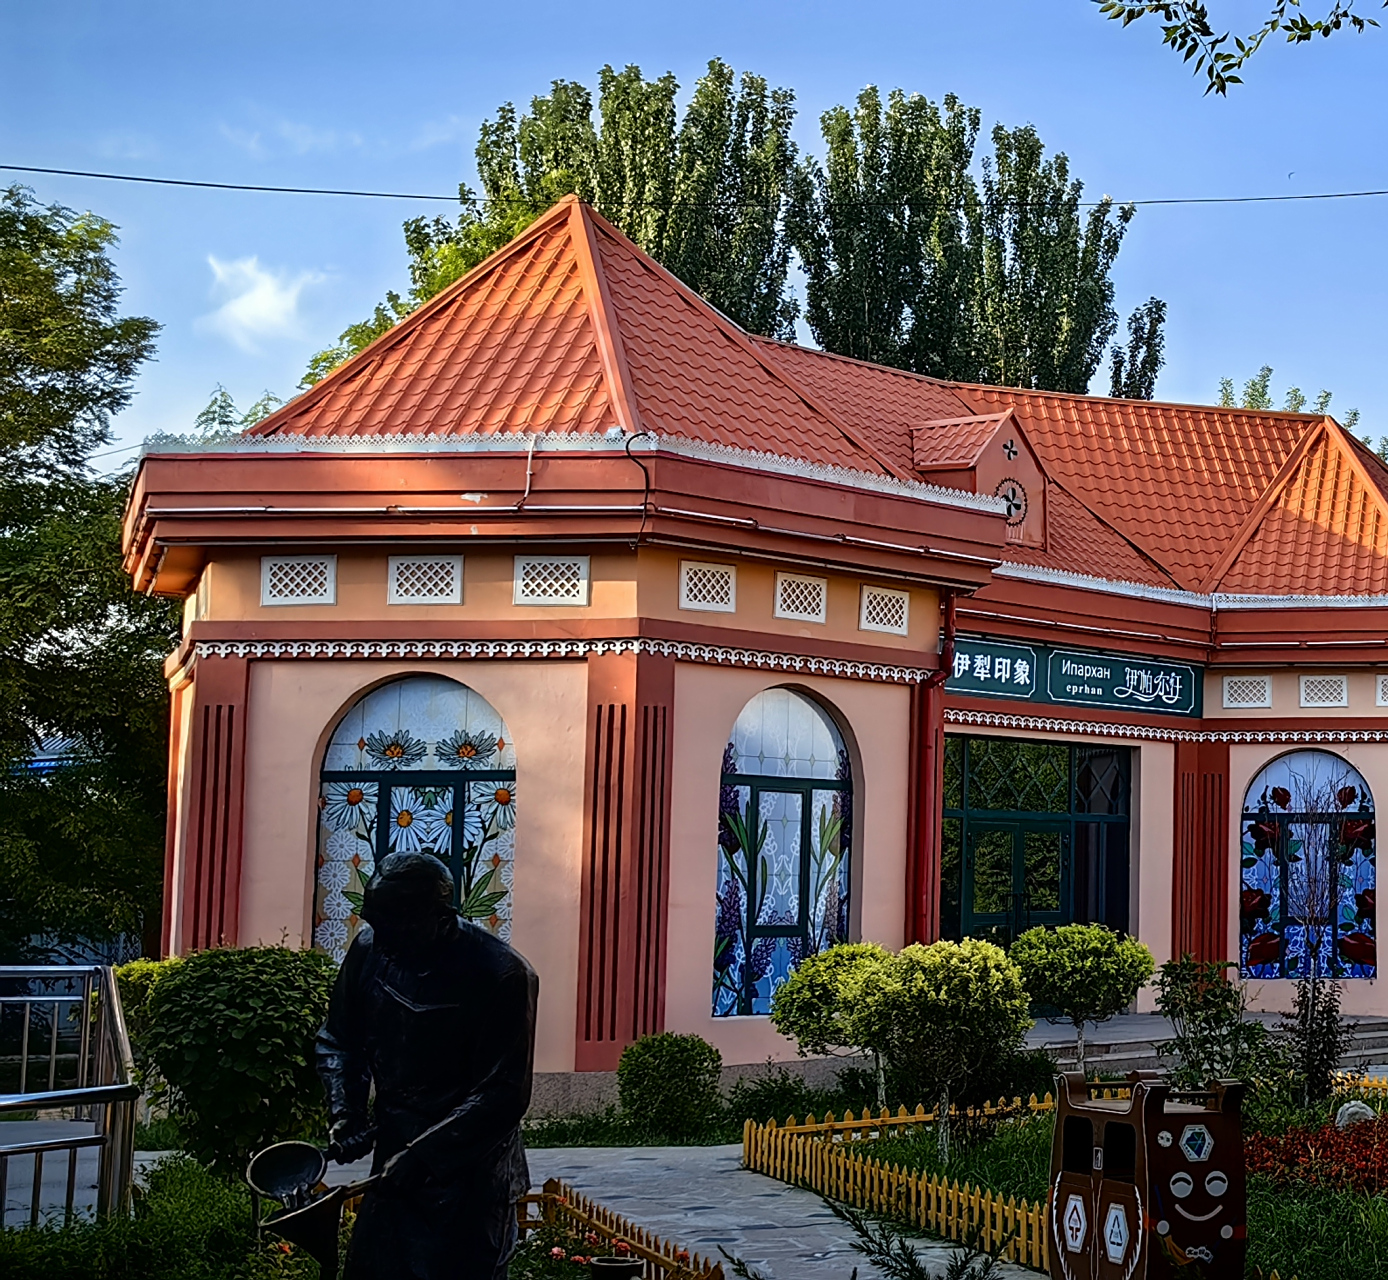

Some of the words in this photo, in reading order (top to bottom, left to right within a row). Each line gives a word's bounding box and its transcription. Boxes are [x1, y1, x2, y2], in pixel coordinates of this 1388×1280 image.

[952, 652, 1030, 685] 伊犁印象
[1062, 659, 1111, 680] Ипархан
[1066, 684, 1103, 695] eprhan
